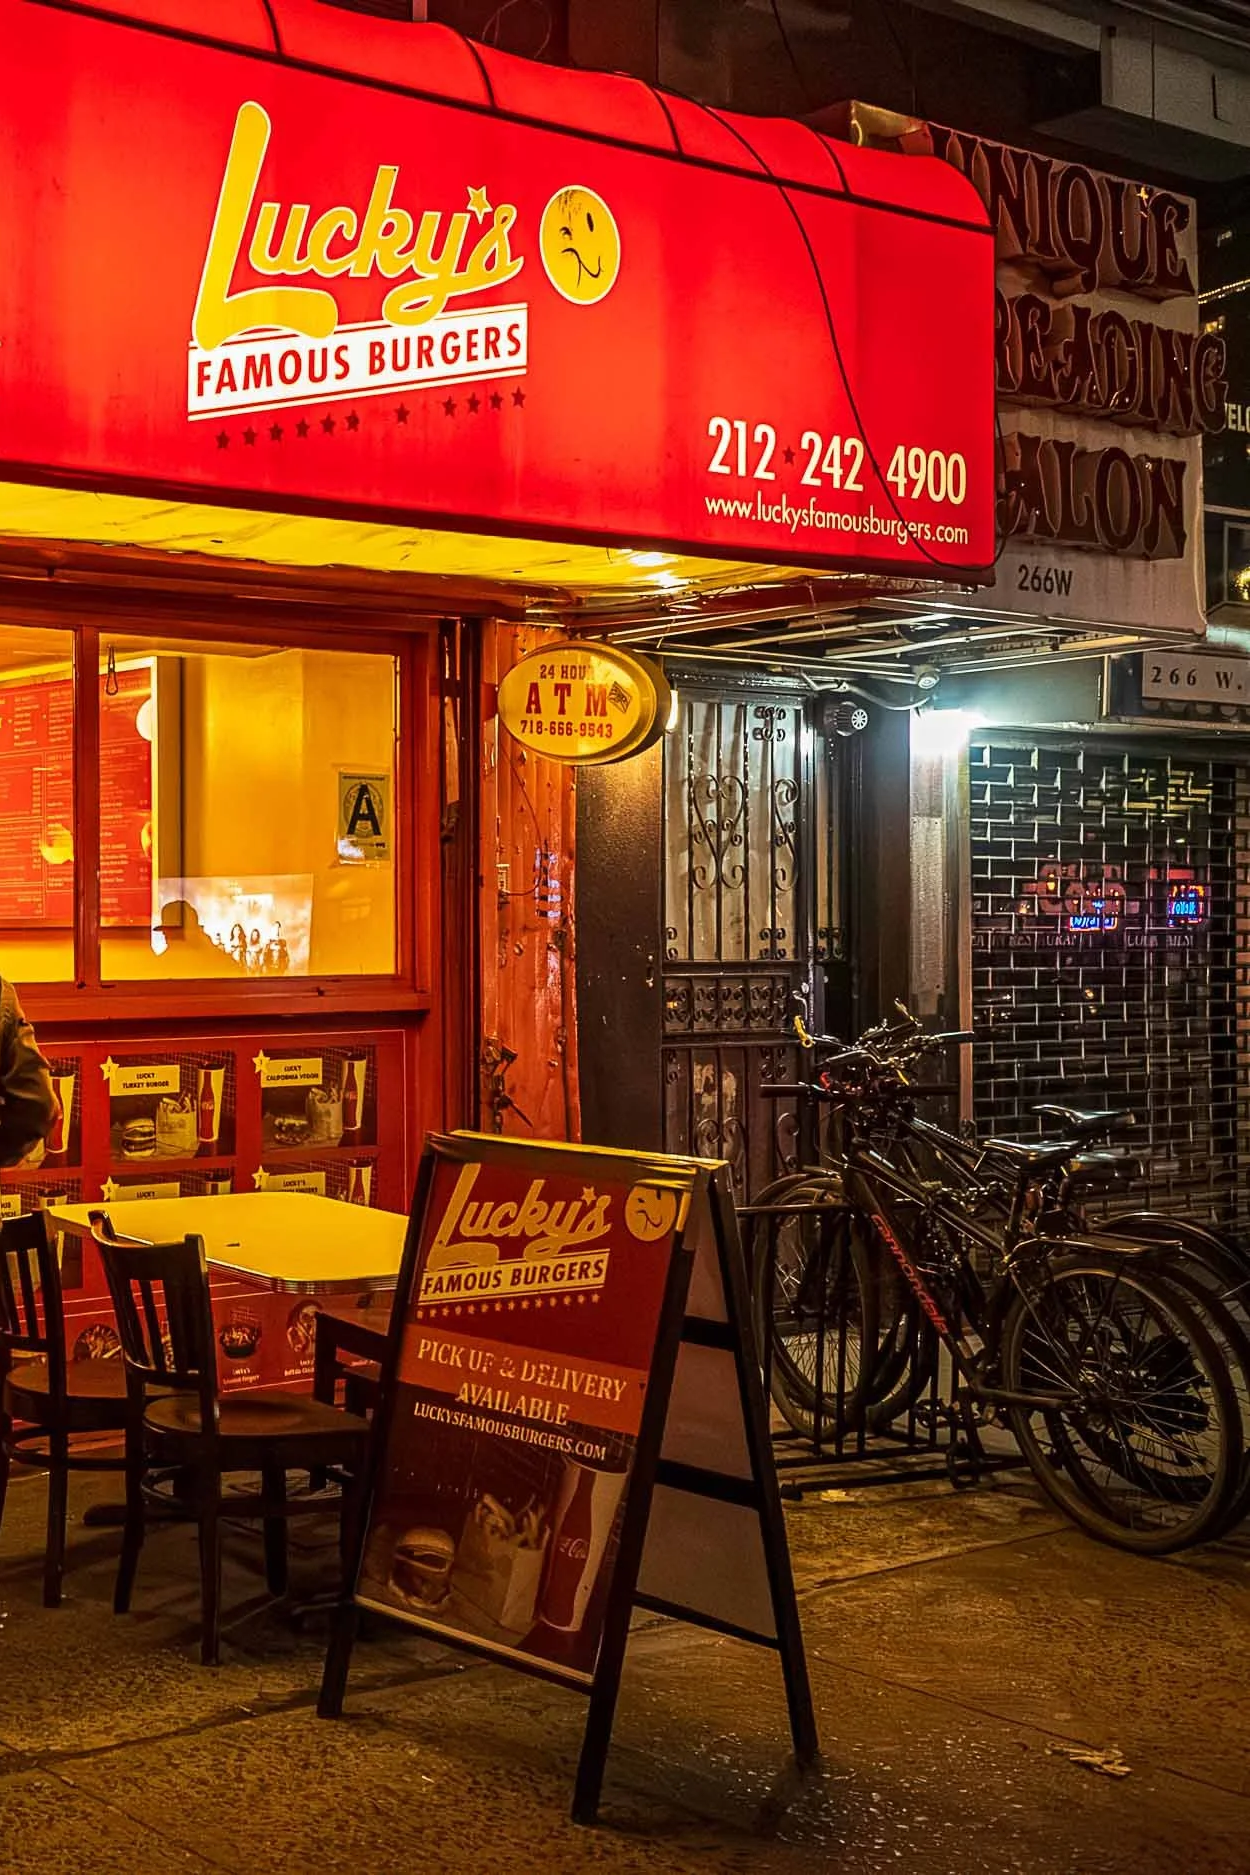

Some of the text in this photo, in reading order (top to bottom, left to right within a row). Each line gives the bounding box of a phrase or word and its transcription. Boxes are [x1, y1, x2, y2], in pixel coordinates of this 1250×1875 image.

[191, 100, 525, 351] Lucky's
[196, 322, 522, 397] FAMOUS BURGERS
[707, 416, 968, 506] 212 242 4900
[705, 491, 969, 545] www.luckysfamousburgers.com
[1018, 563, 1074, 597] 266W
[539, 664, 593, 681] 24 HOU
[1150, 666, 1243, 691] 266 W.
[525, 682, 608, 727] ATM
[346, 784, 382, 836] A
[426, 1162, 613, 1272] Lucky's
[422, 1258, 604, 1296] FAMOUS BURGERS
[417, 1338, 463, 1368] PICK
[520, 1360, 628, 1402] DELIVERY
[455, 1381, 570, 1426] AVAILABLE
[413, 1401, 607, 1461] LUCKYSFAMOUSBURGERS.COM
